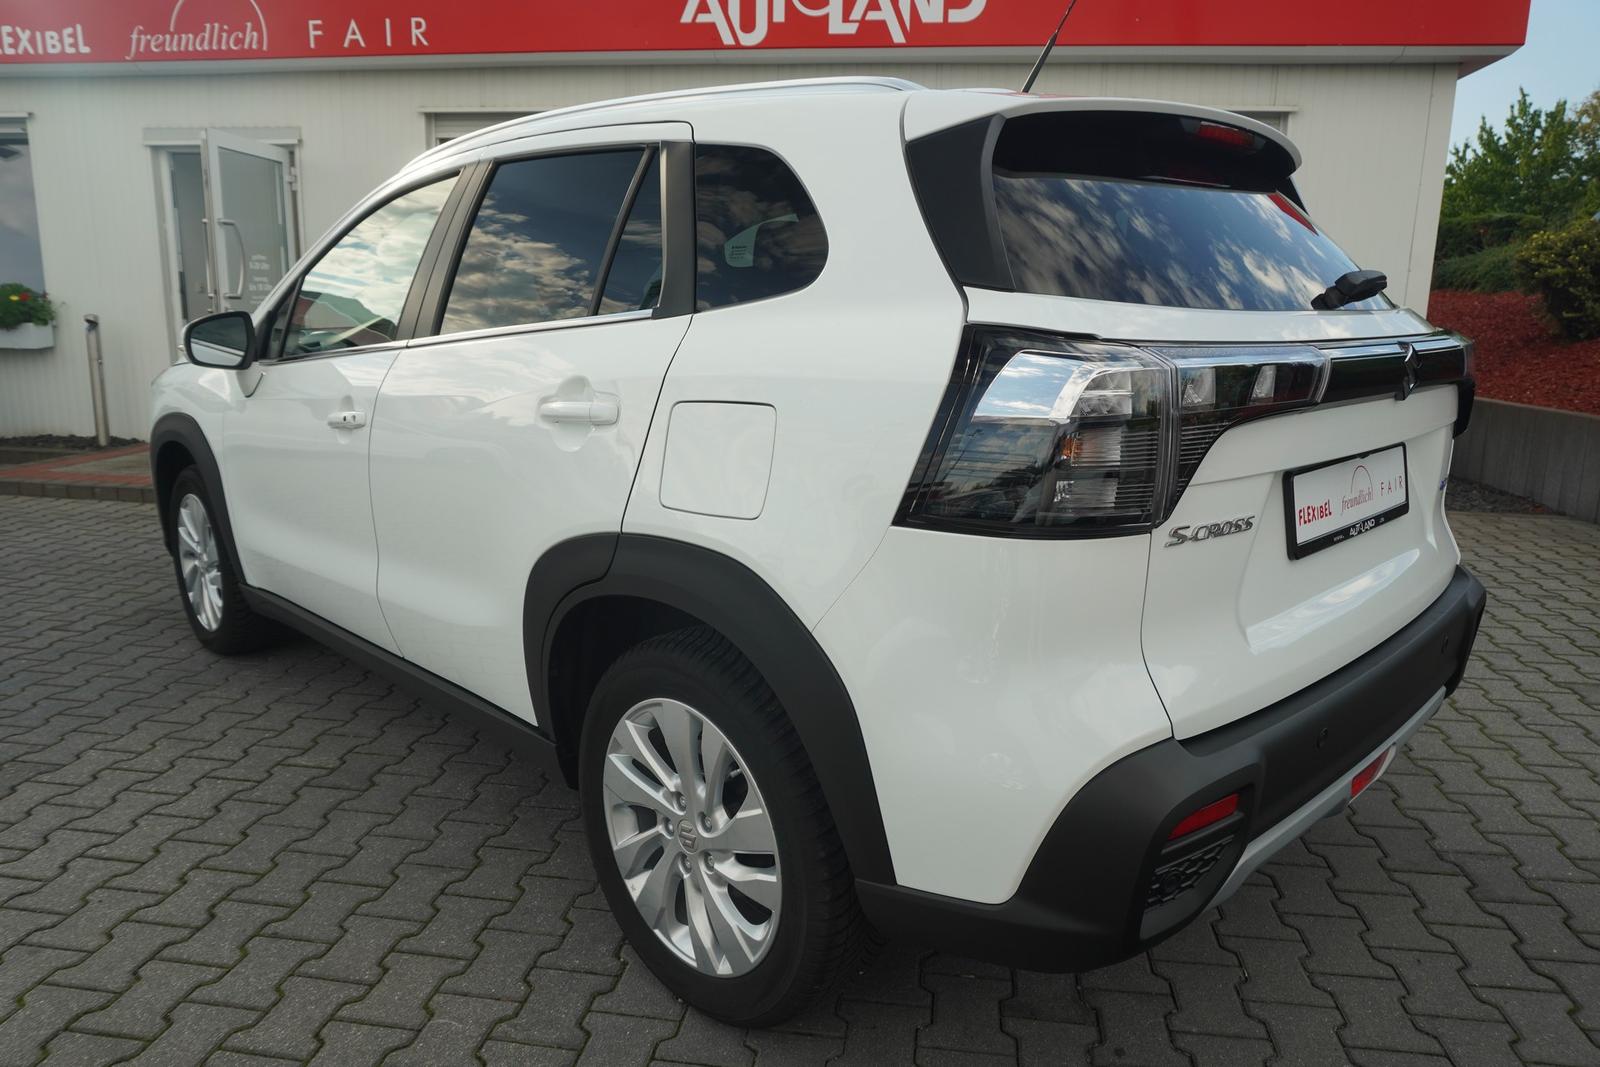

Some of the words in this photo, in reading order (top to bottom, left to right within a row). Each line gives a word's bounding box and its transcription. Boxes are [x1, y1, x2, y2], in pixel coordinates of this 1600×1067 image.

[0, 23, 91, 55] EXIBEL
[125, 22, 258, 60] freundlich
[308, 17, 429, 49] FAIR
[1298, 499, 1332, 526] FLEXIBEL
[1340, 487, 1372, 516] freundlich
[1380, 475, 1404, 496] FAIR
